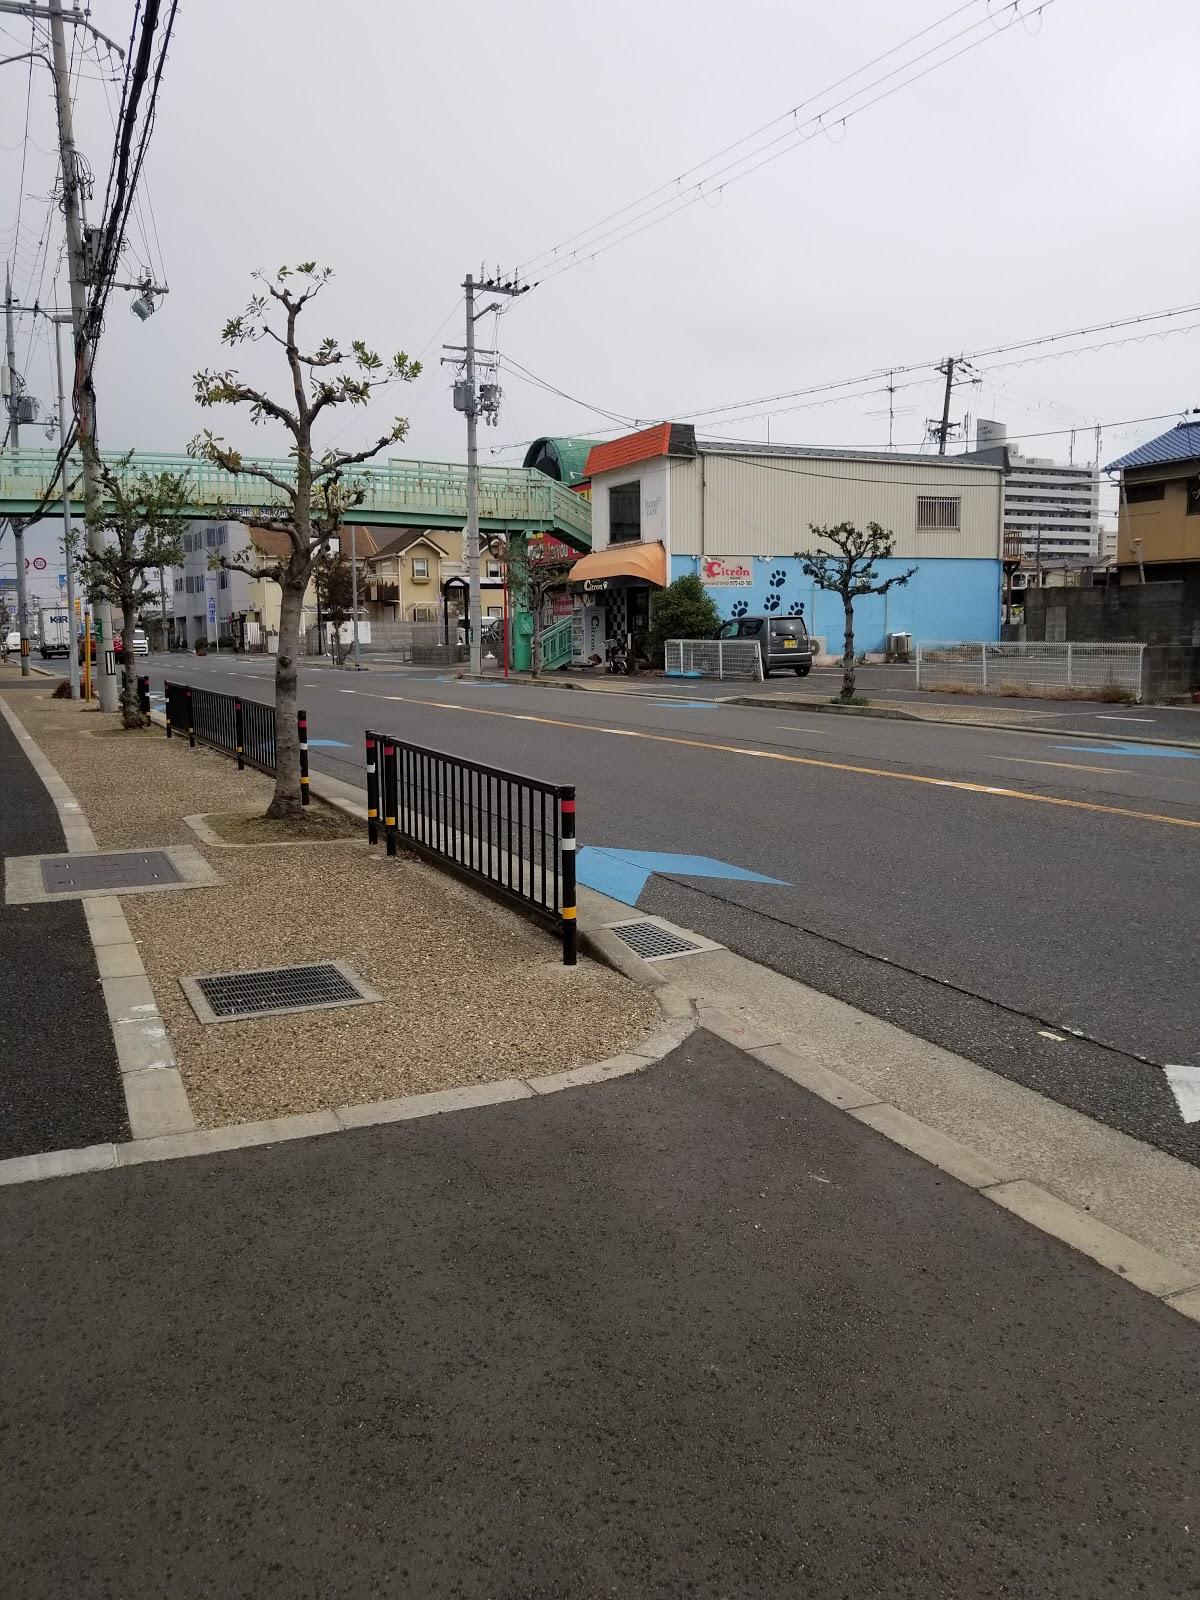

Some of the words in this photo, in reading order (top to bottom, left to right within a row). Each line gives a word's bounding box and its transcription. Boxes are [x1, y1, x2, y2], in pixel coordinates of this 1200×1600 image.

[705, 561, 750, 577] Citron
[584, 579, 603, 591] Citron
[591, 615, 600, 650] Citron
